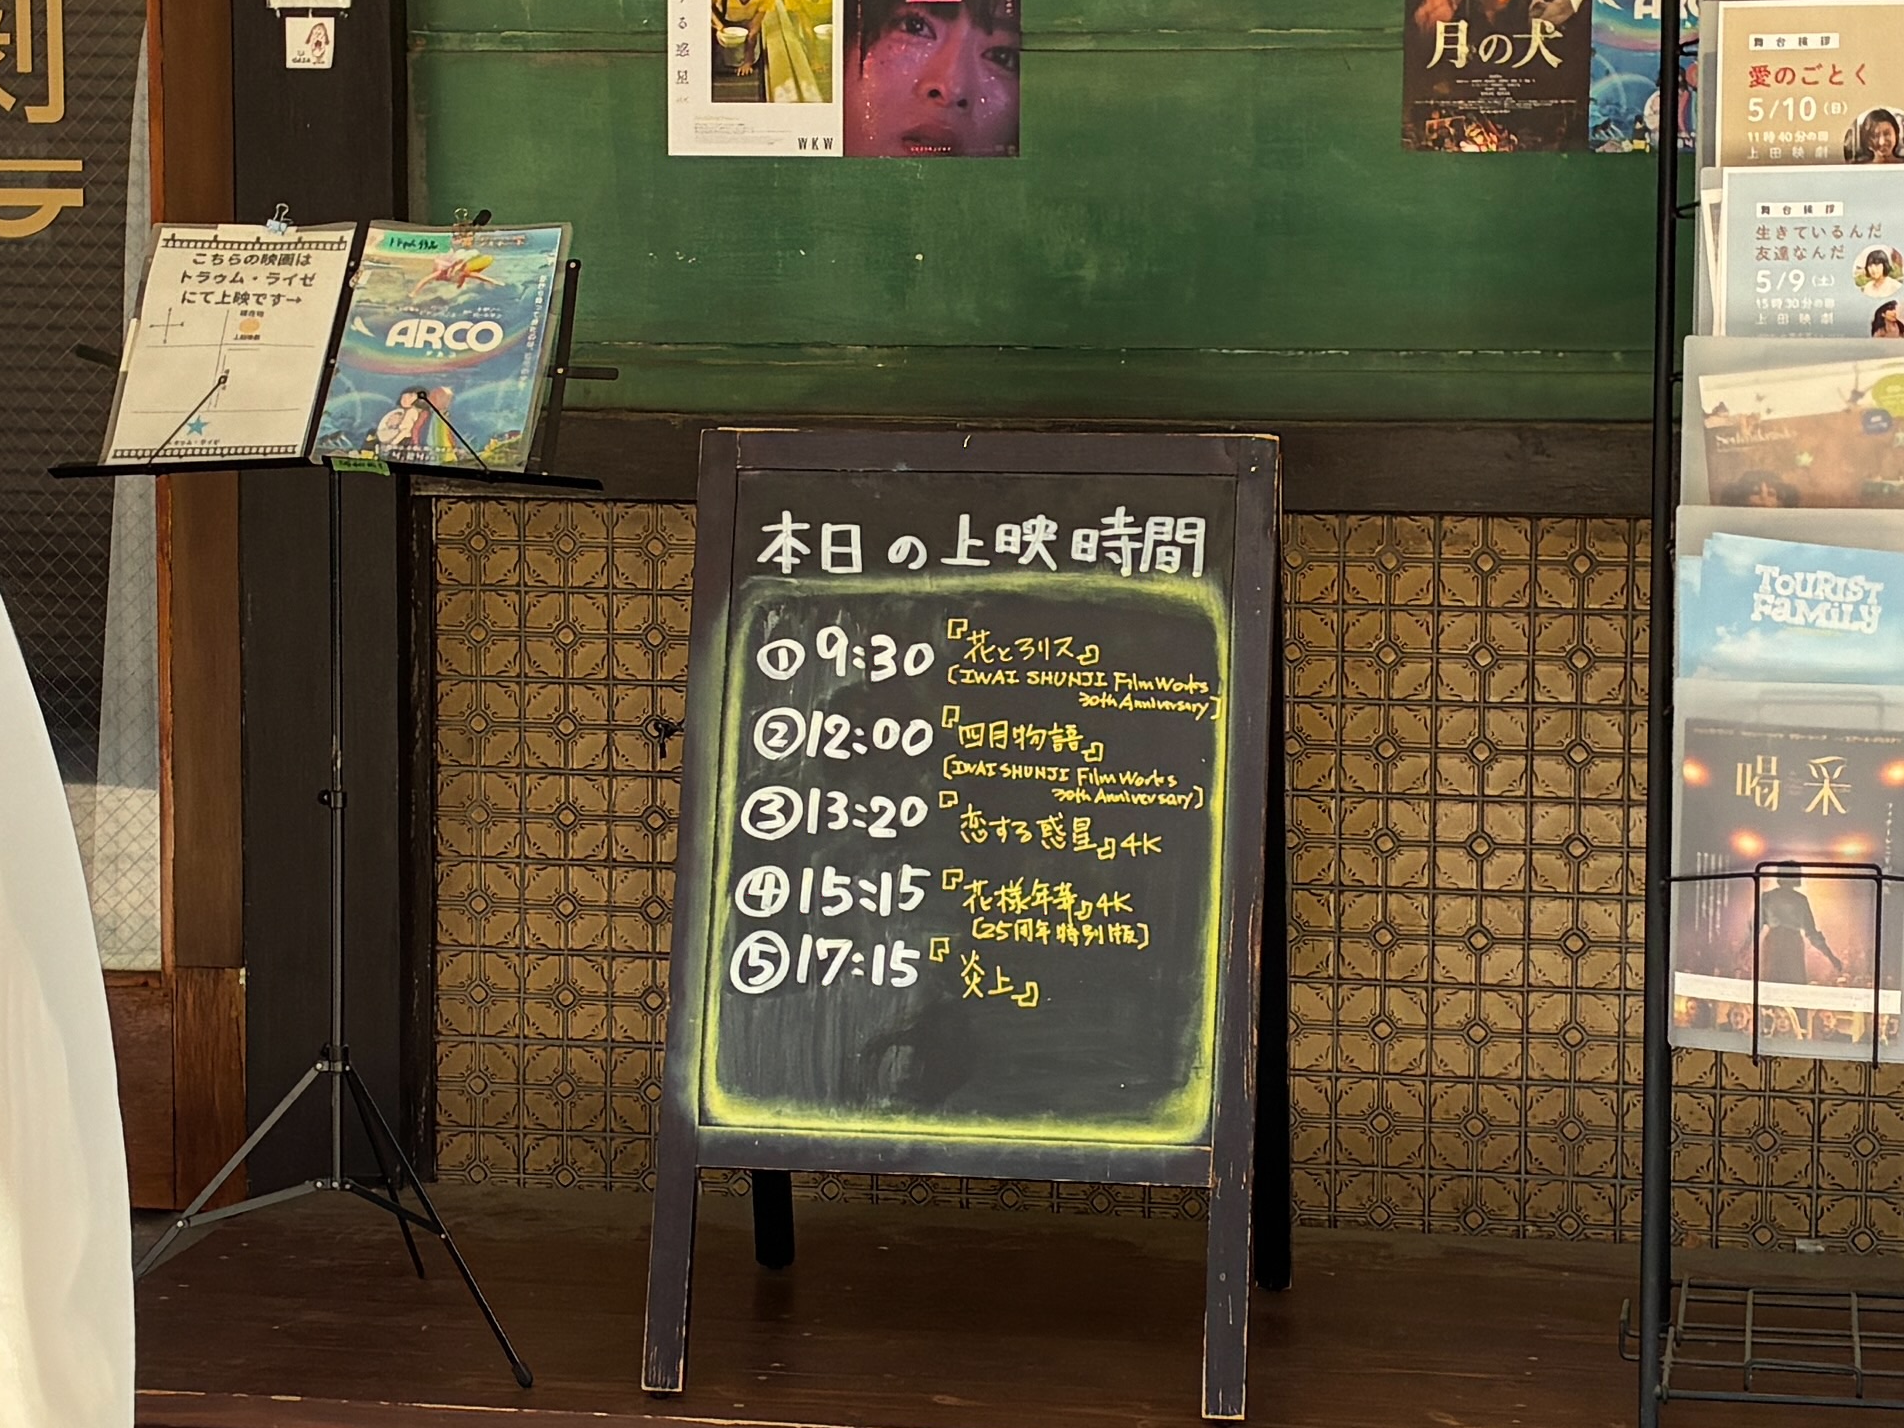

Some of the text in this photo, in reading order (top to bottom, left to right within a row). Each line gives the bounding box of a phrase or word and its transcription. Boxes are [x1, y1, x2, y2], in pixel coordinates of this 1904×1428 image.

[1425, 18, 1564, 70] 月の犬
[1748, 63, 1868, 88] 愛のごとく
[1748, 96, 1817, 122] 5/10
[1754, 223, 1883, 241] 生きているんだ
[190, 251, 313, 269] こちらの映画は
[1754, 244, 1846, 262] 友達なんだ
[1755, 269, 1806, 294] 5/9
[385, 318, 504, 353] ARCO
[755, 505, 1208, 578] 本日の上映時間
[1026, 670, 1109, 689] SHUNJI
[1001, 761, 1070, 783] SHUNJI
[1735, 753, 1853, 816] 喝采
